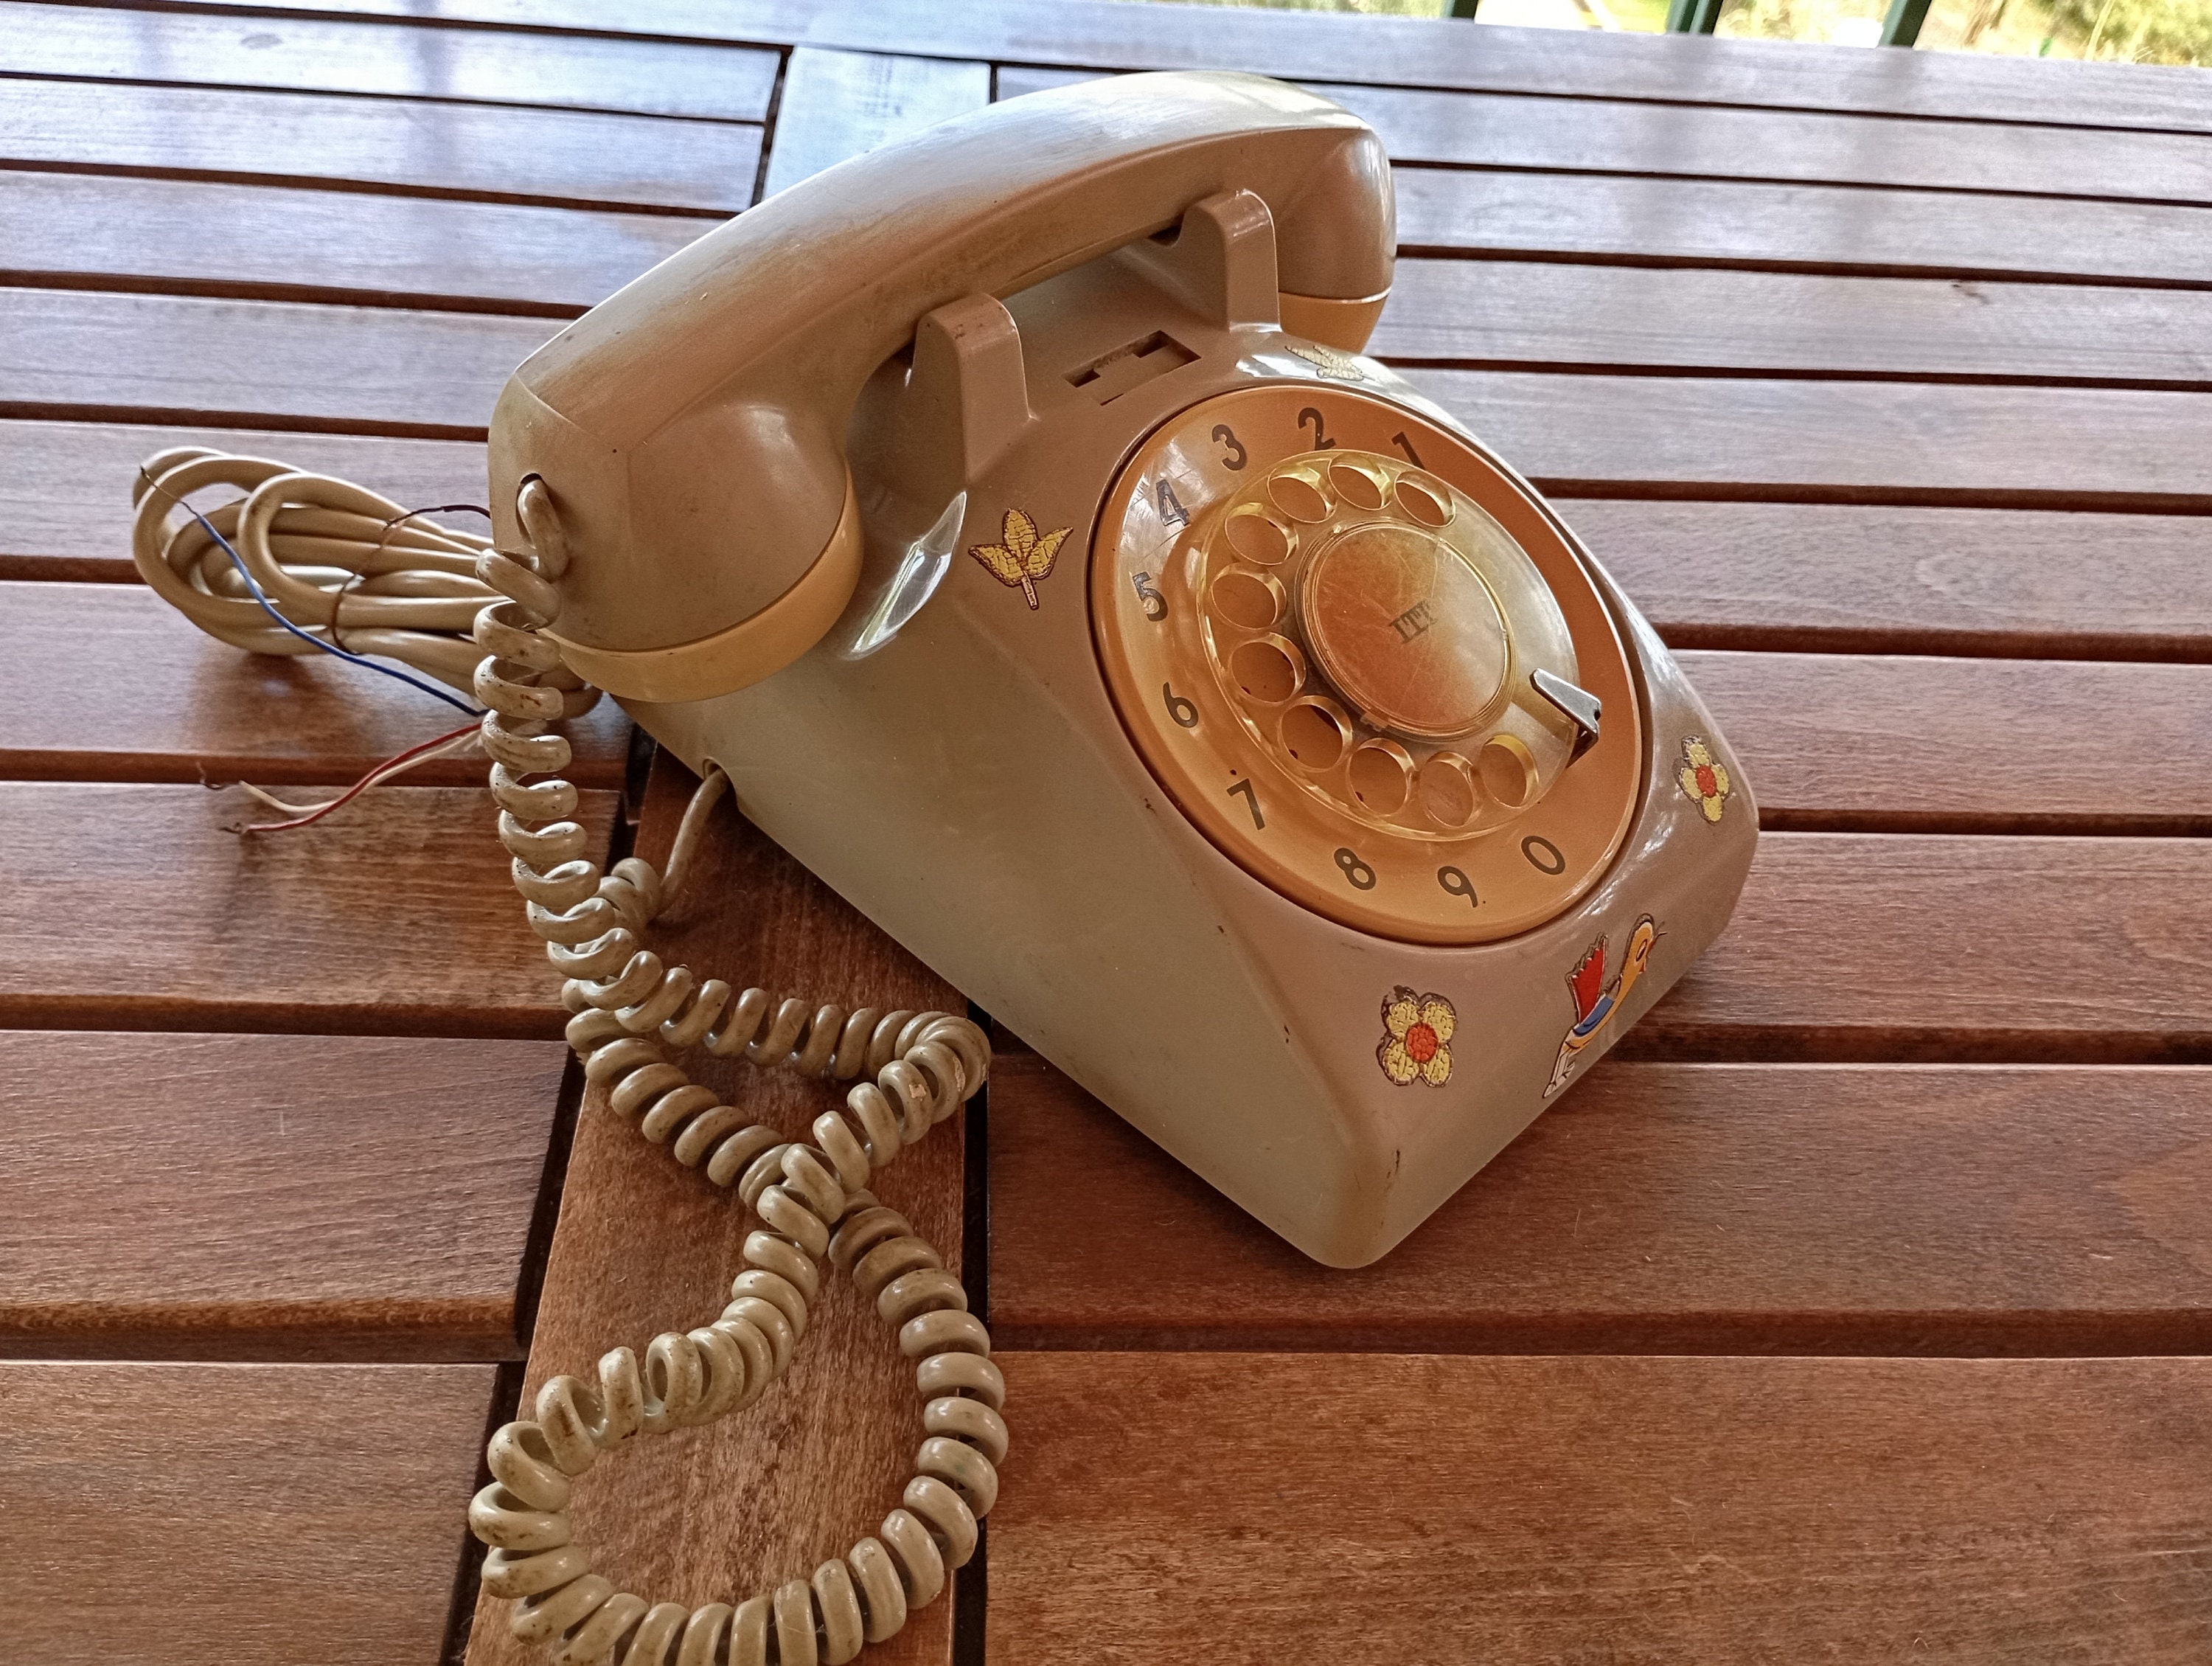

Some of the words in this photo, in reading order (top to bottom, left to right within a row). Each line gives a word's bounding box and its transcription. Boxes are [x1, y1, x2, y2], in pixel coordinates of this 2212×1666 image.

[1211, 424, 1247, 471] 3
[1297, 408, 1335, 449] 2
[1392, 432, 1426, 470] 1
[1157, 479, 1190, 526] 4
[1133, 572, 1169, 622] 5
[1163, 681, 1199, 728] 6
[1227, 779, 1265, 830] 7
[1334, 847, 1376, 890] 8
[1521, 836, 1565, 875] 0
[1437, 866, 1478, 908] 9
